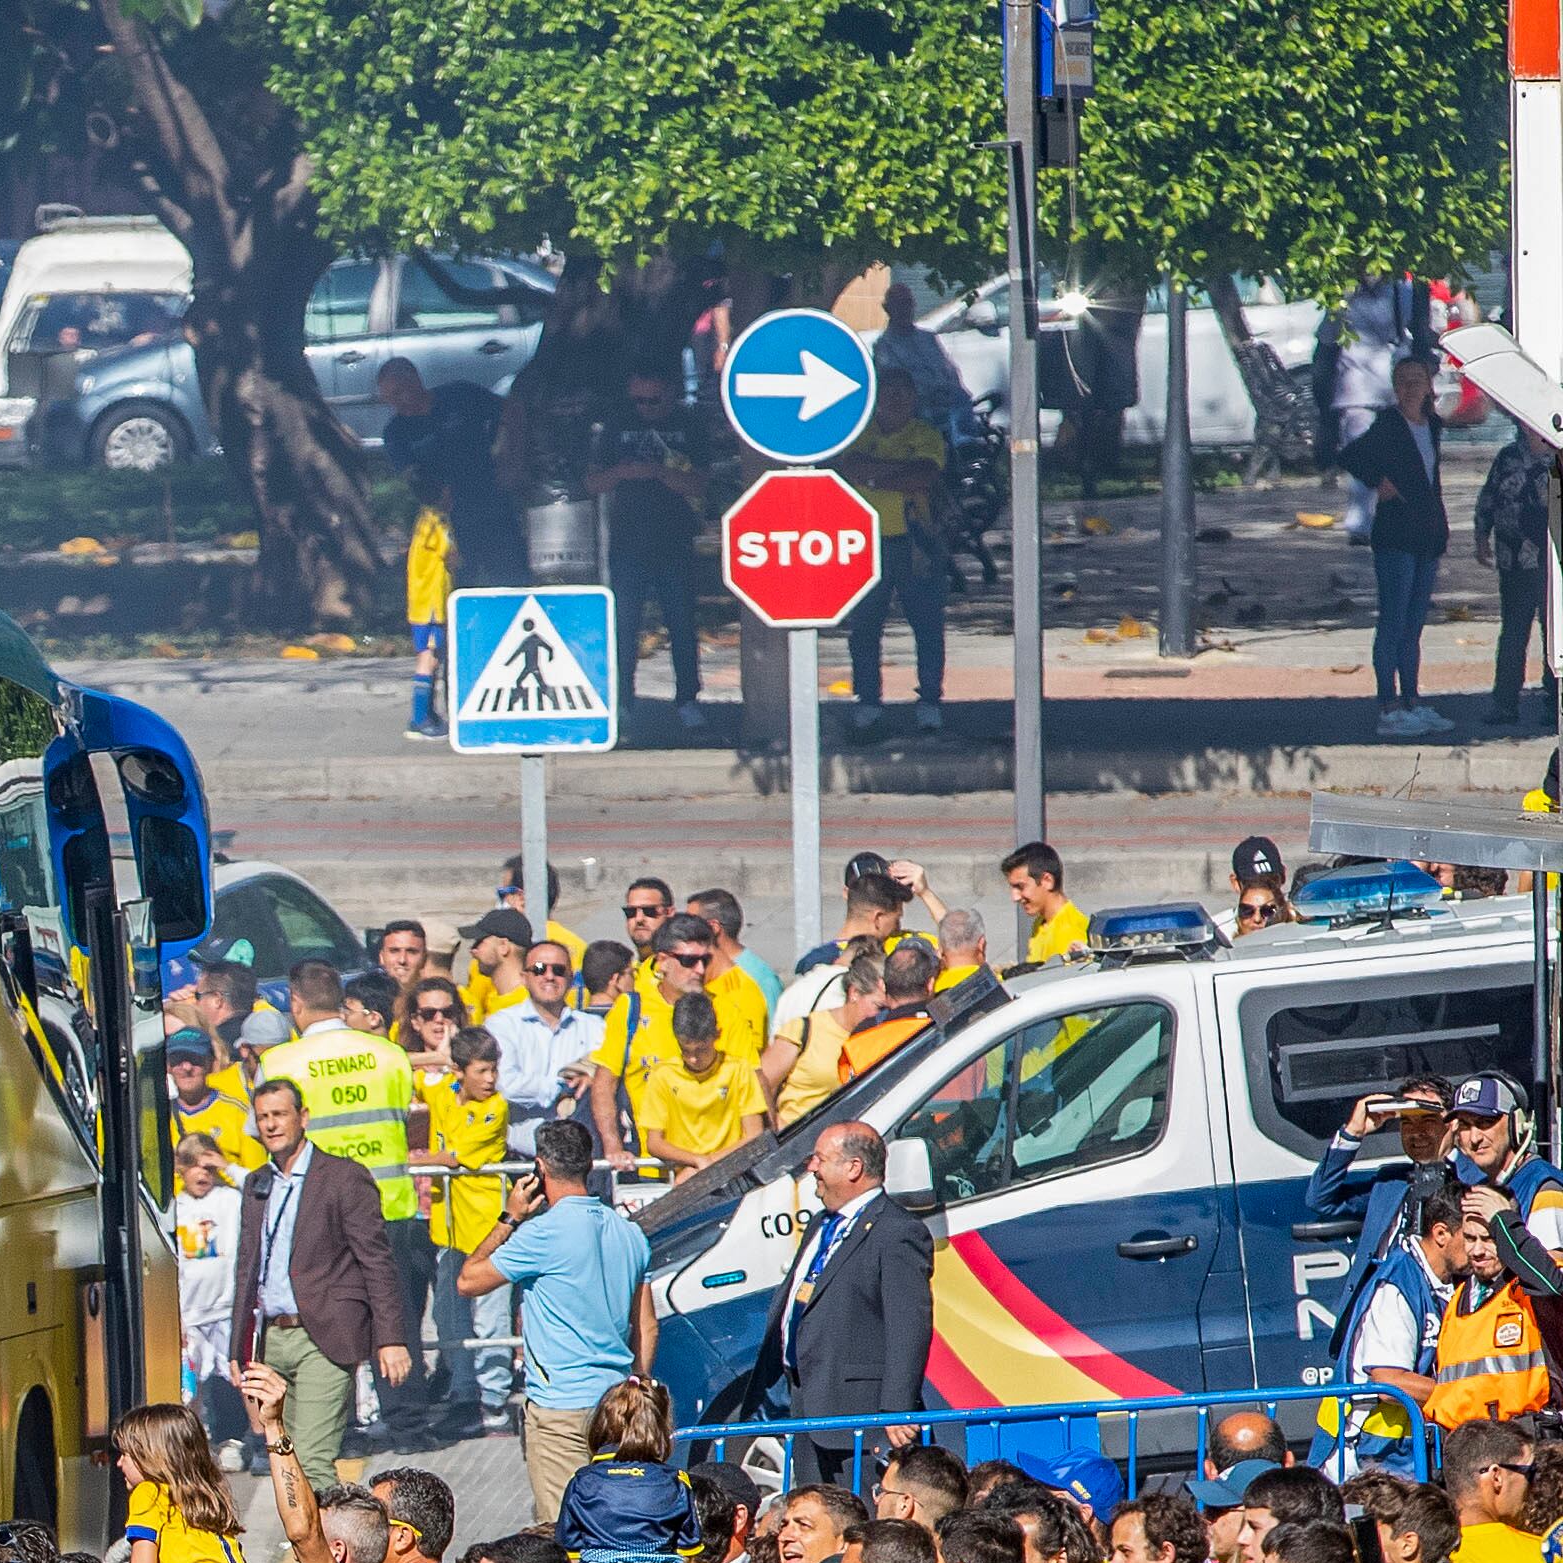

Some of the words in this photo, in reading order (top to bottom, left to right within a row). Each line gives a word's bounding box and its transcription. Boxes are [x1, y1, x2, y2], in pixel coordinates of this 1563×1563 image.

[737, 529, 866, 568] STOP
[308, 1052, 377, 1078] STEWARD
[331, 1084, 367, 1106] 050
